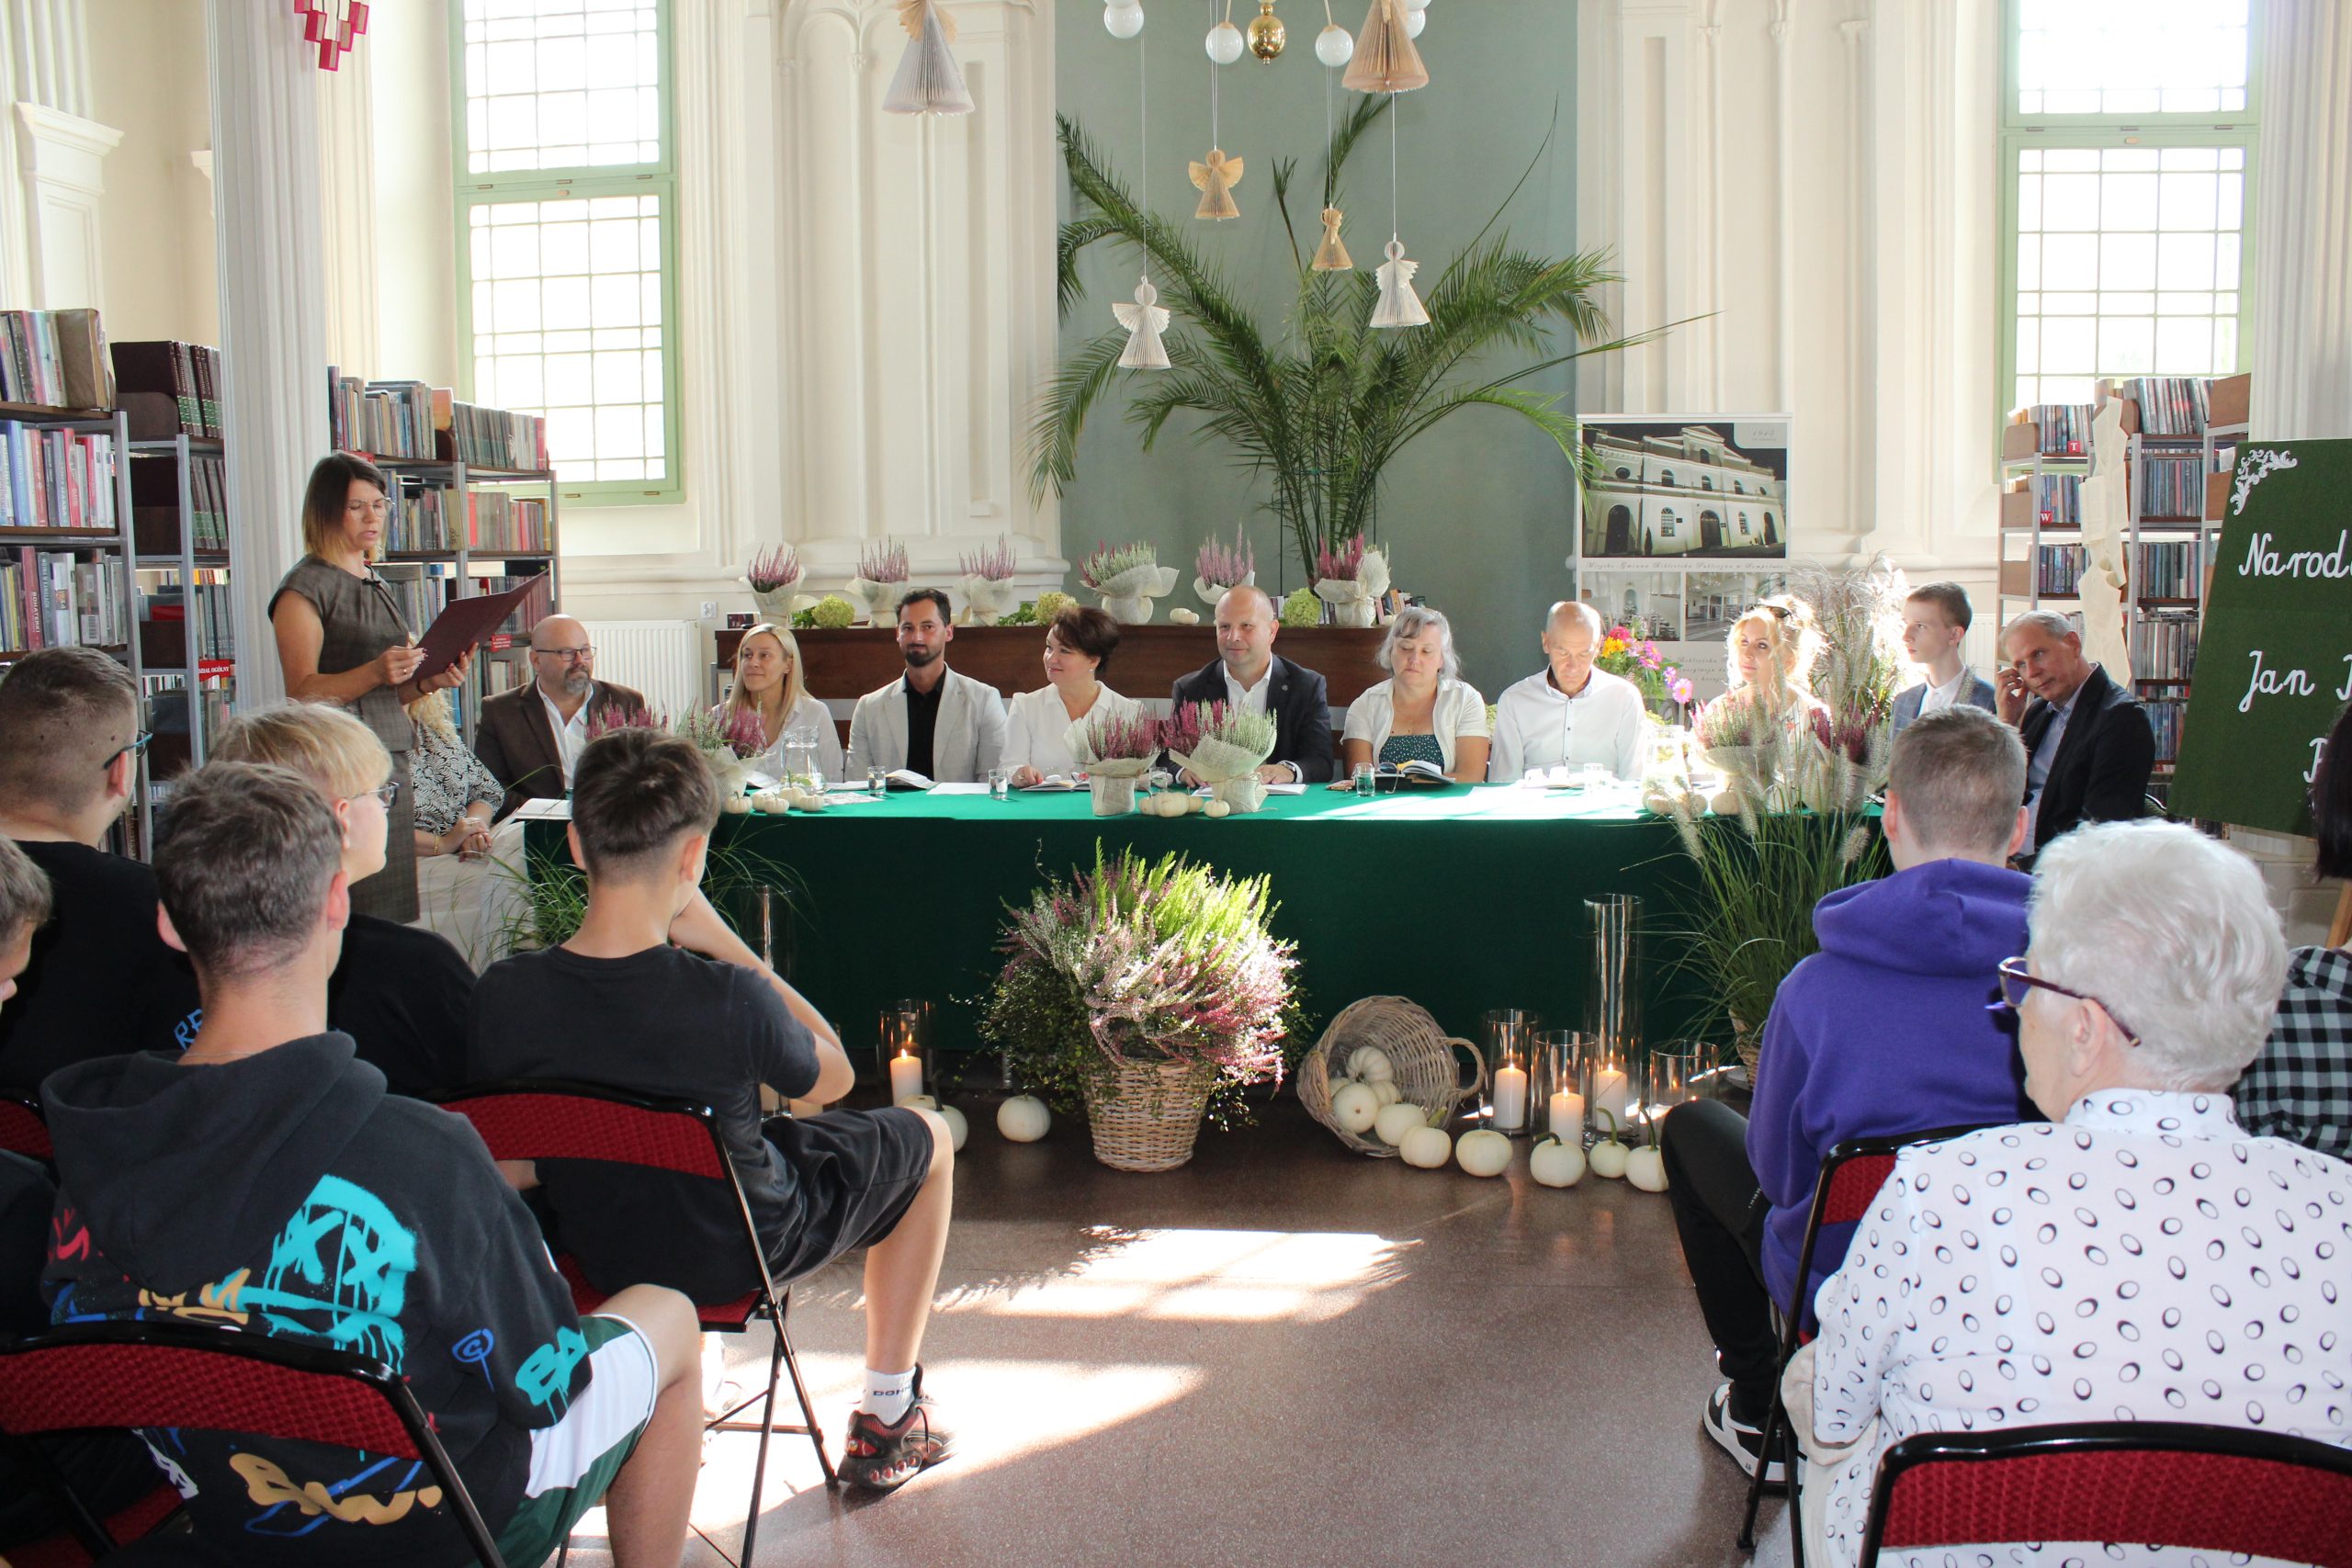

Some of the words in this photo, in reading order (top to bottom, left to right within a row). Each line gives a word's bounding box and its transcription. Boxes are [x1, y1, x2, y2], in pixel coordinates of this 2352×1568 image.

[2070, 442, 2078, 451] T
[2041, 513, 2052, 522] W
[2238, 529, 2352, 579] Narod
[2238, 650, 2315, 713] Jan
